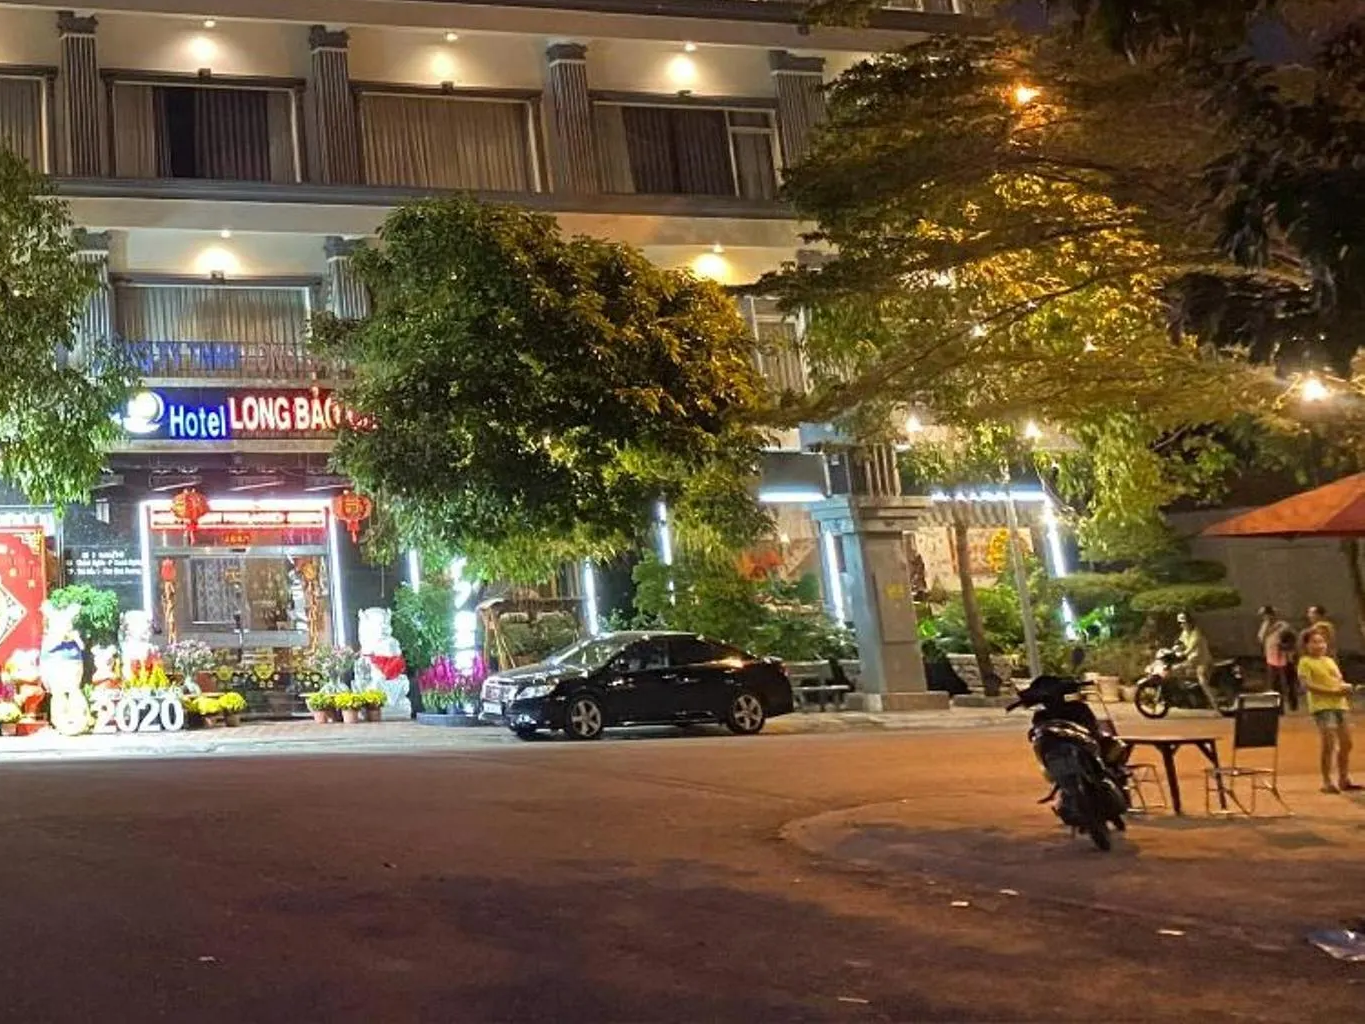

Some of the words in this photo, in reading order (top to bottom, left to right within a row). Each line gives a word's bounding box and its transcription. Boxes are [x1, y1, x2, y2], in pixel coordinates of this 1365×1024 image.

[169, 404, 226, 437] Hotel
[228, 396, 292, 430] LONG
[93, 694, 184, 733] 2020
